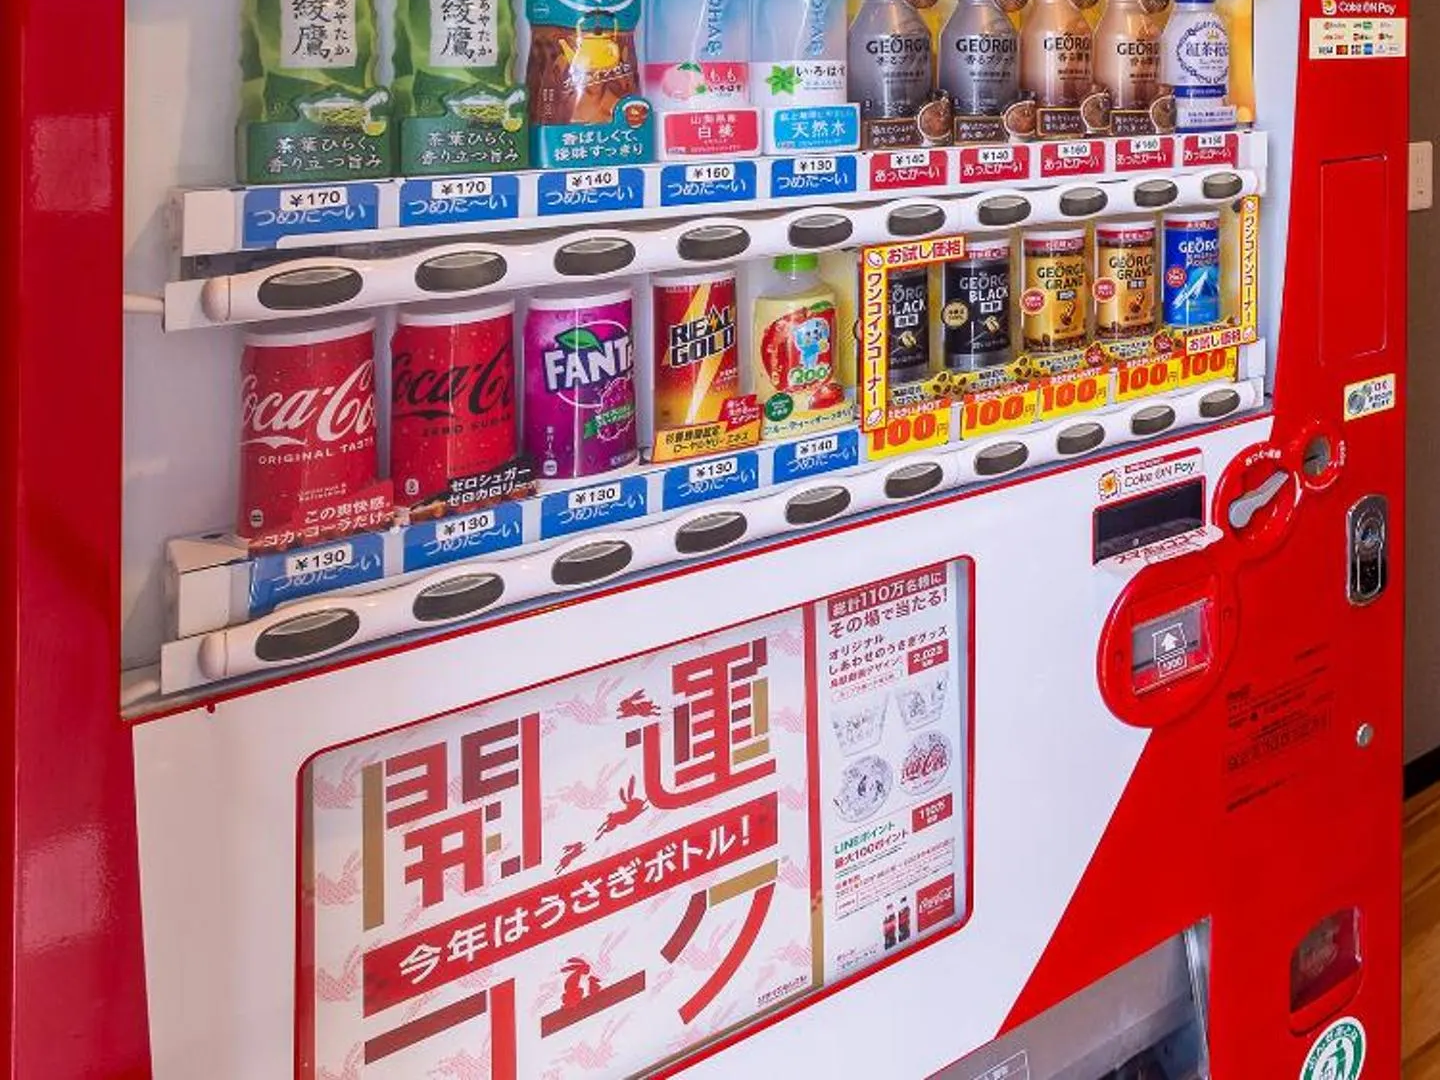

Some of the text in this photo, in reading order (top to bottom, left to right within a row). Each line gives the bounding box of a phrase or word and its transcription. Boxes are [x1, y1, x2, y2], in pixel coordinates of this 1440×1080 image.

[1378, 2, 1396, 15] Pay
[709, 69, 737, 82] もも
[699, 124, 735, 139] 白桃
[791, 120, 846, 139] 天然水
[420, 147, 520, 166] 香り立つ旨み
[554, 143, 643, 161] 後味すっきり
[269, 155, 383, 173] 香り立つ旨み
[441, 181, 486, 196] ¥170
[571, 172, 613, 187] ¥140
[289, 191, 342, 208] ¥170
[887, 239, 961, 264] お試し価格
[1244, 213, 1254, 322] ワンコインコーナー
[969, 287, 1009, 304] BLACK
[671, 306, 734, 347] REAL
[867, 272, 883, 406] ワンコインコーナー
[1188, 329, 1241, 351] お試し価格
[670, 331, 736, 368] GOLD
[544, 340, 634, 391] FANT
[800, 440, 833, 454] ¥140
[258, 449, 334, 466] ORIGINAL
[696, 462, 733, 477] ¥130
[1174, 461, 1196, 475] Pay
[450, 466, 532, 493] ゼロシュガー
[575, 488, 616, 504] ¥130
[444, 514, 489, 535] ¥130
[295, 549, 346, 571] ¥130
[829, 587, 949, 639] その場で当たる!
[829, 632, 884, 660] オリジナル
[829, 624, 948, 676] しあわせのうさぎグッズ
[399, 815, 751, 985] 今年はうさぎボトル!
